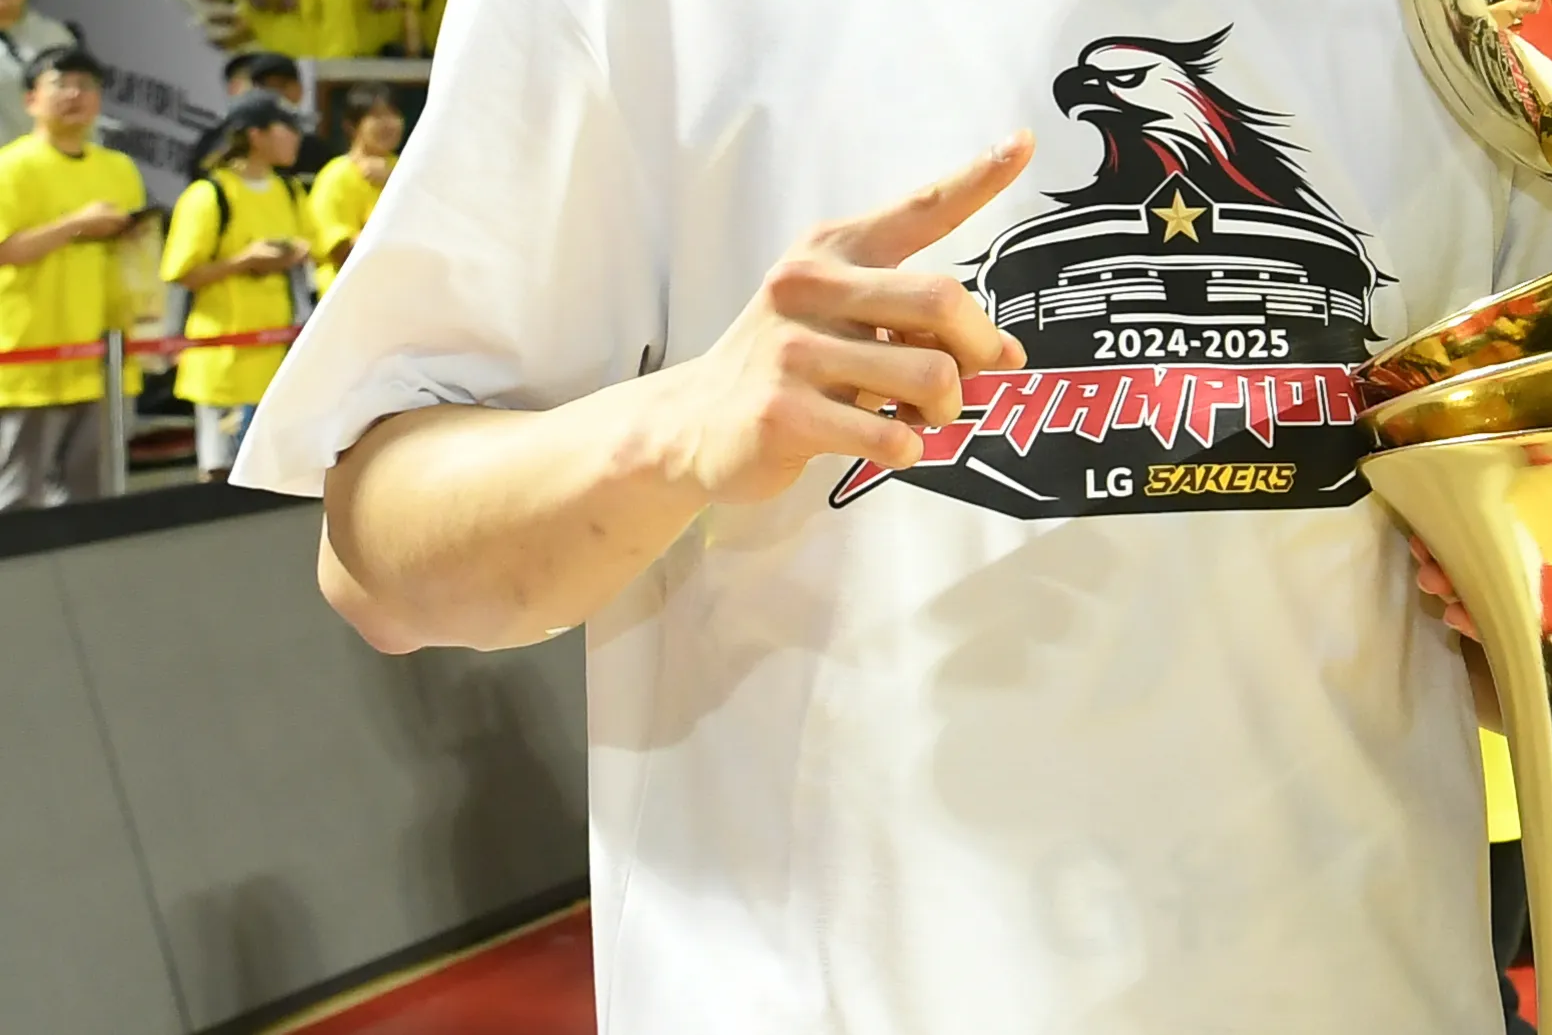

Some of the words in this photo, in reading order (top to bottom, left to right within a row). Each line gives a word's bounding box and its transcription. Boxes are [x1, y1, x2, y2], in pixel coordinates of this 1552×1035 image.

[1093, 328, 1290, 359] 2024-2025
[829, 362, 1358, 509] CHAMPION
[1086, 466, 1133, 499] LG
[1144, 463, 1298, 496] SAKERS
